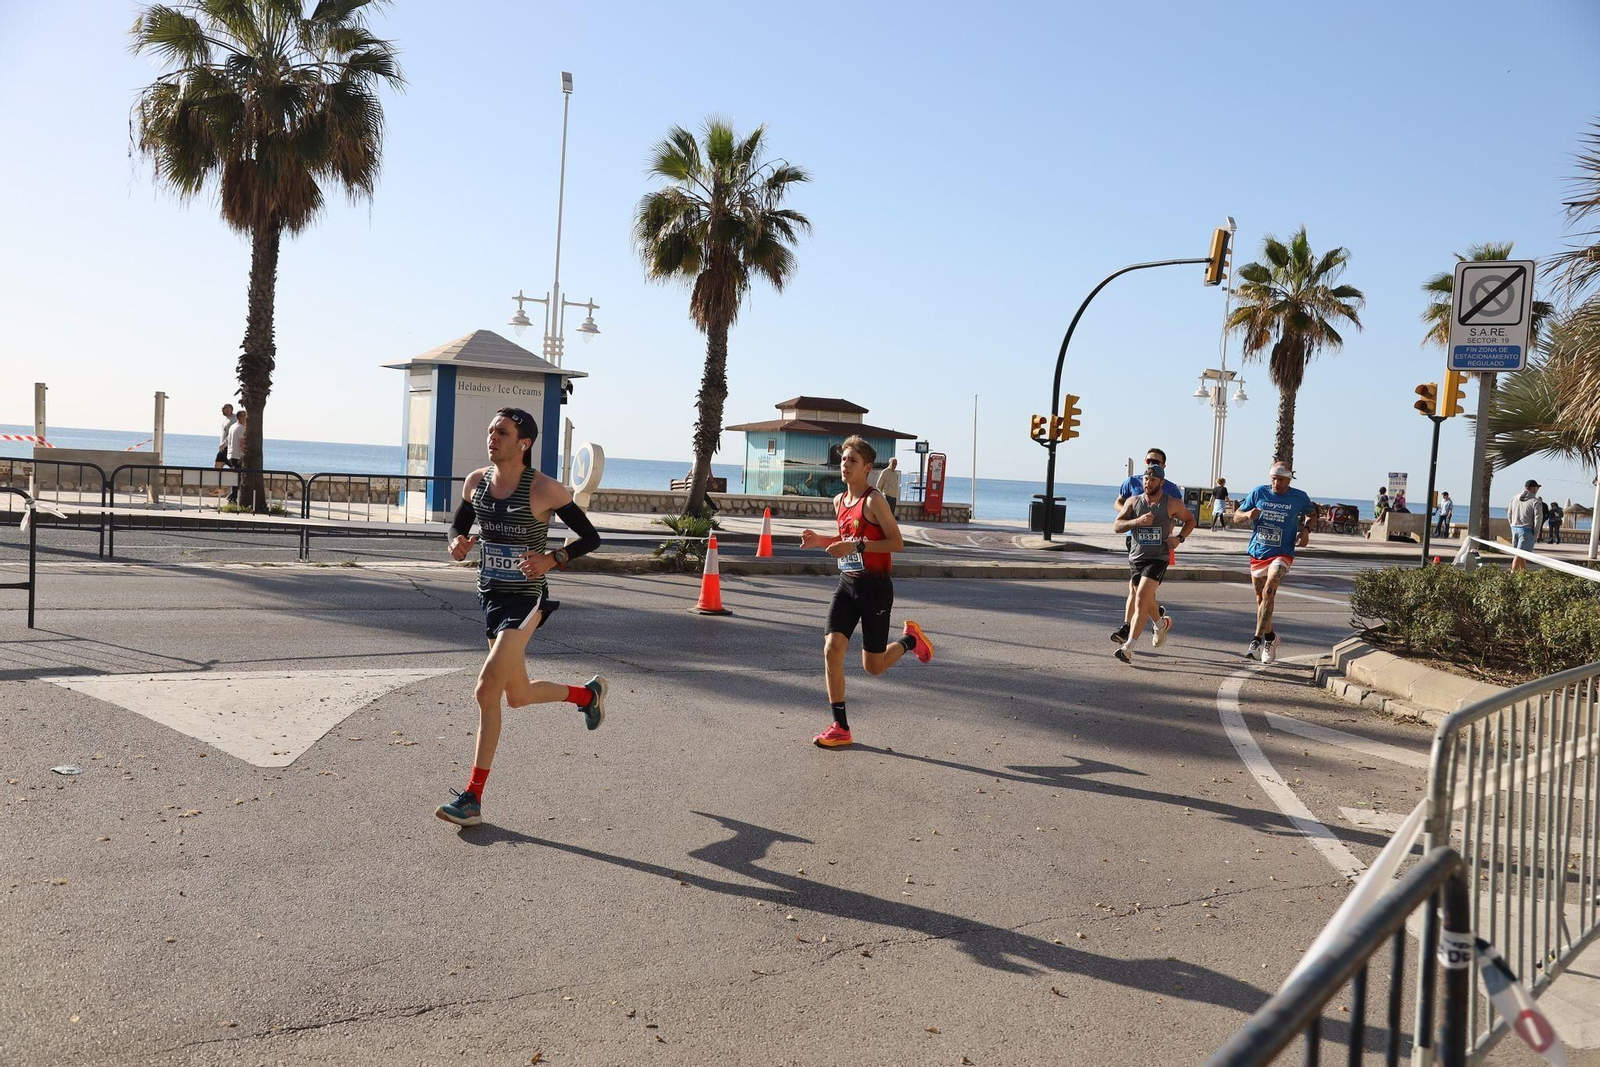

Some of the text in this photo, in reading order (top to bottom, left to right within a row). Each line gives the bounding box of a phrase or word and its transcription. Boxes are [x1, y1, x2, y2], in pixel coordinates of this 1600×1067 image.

[458, 381, 491, 393] Helados
[498, 384, 511, 394] Ice
[512, 385, 542, 397] Creams
[1262, 501, 1292, 510] mayoral
